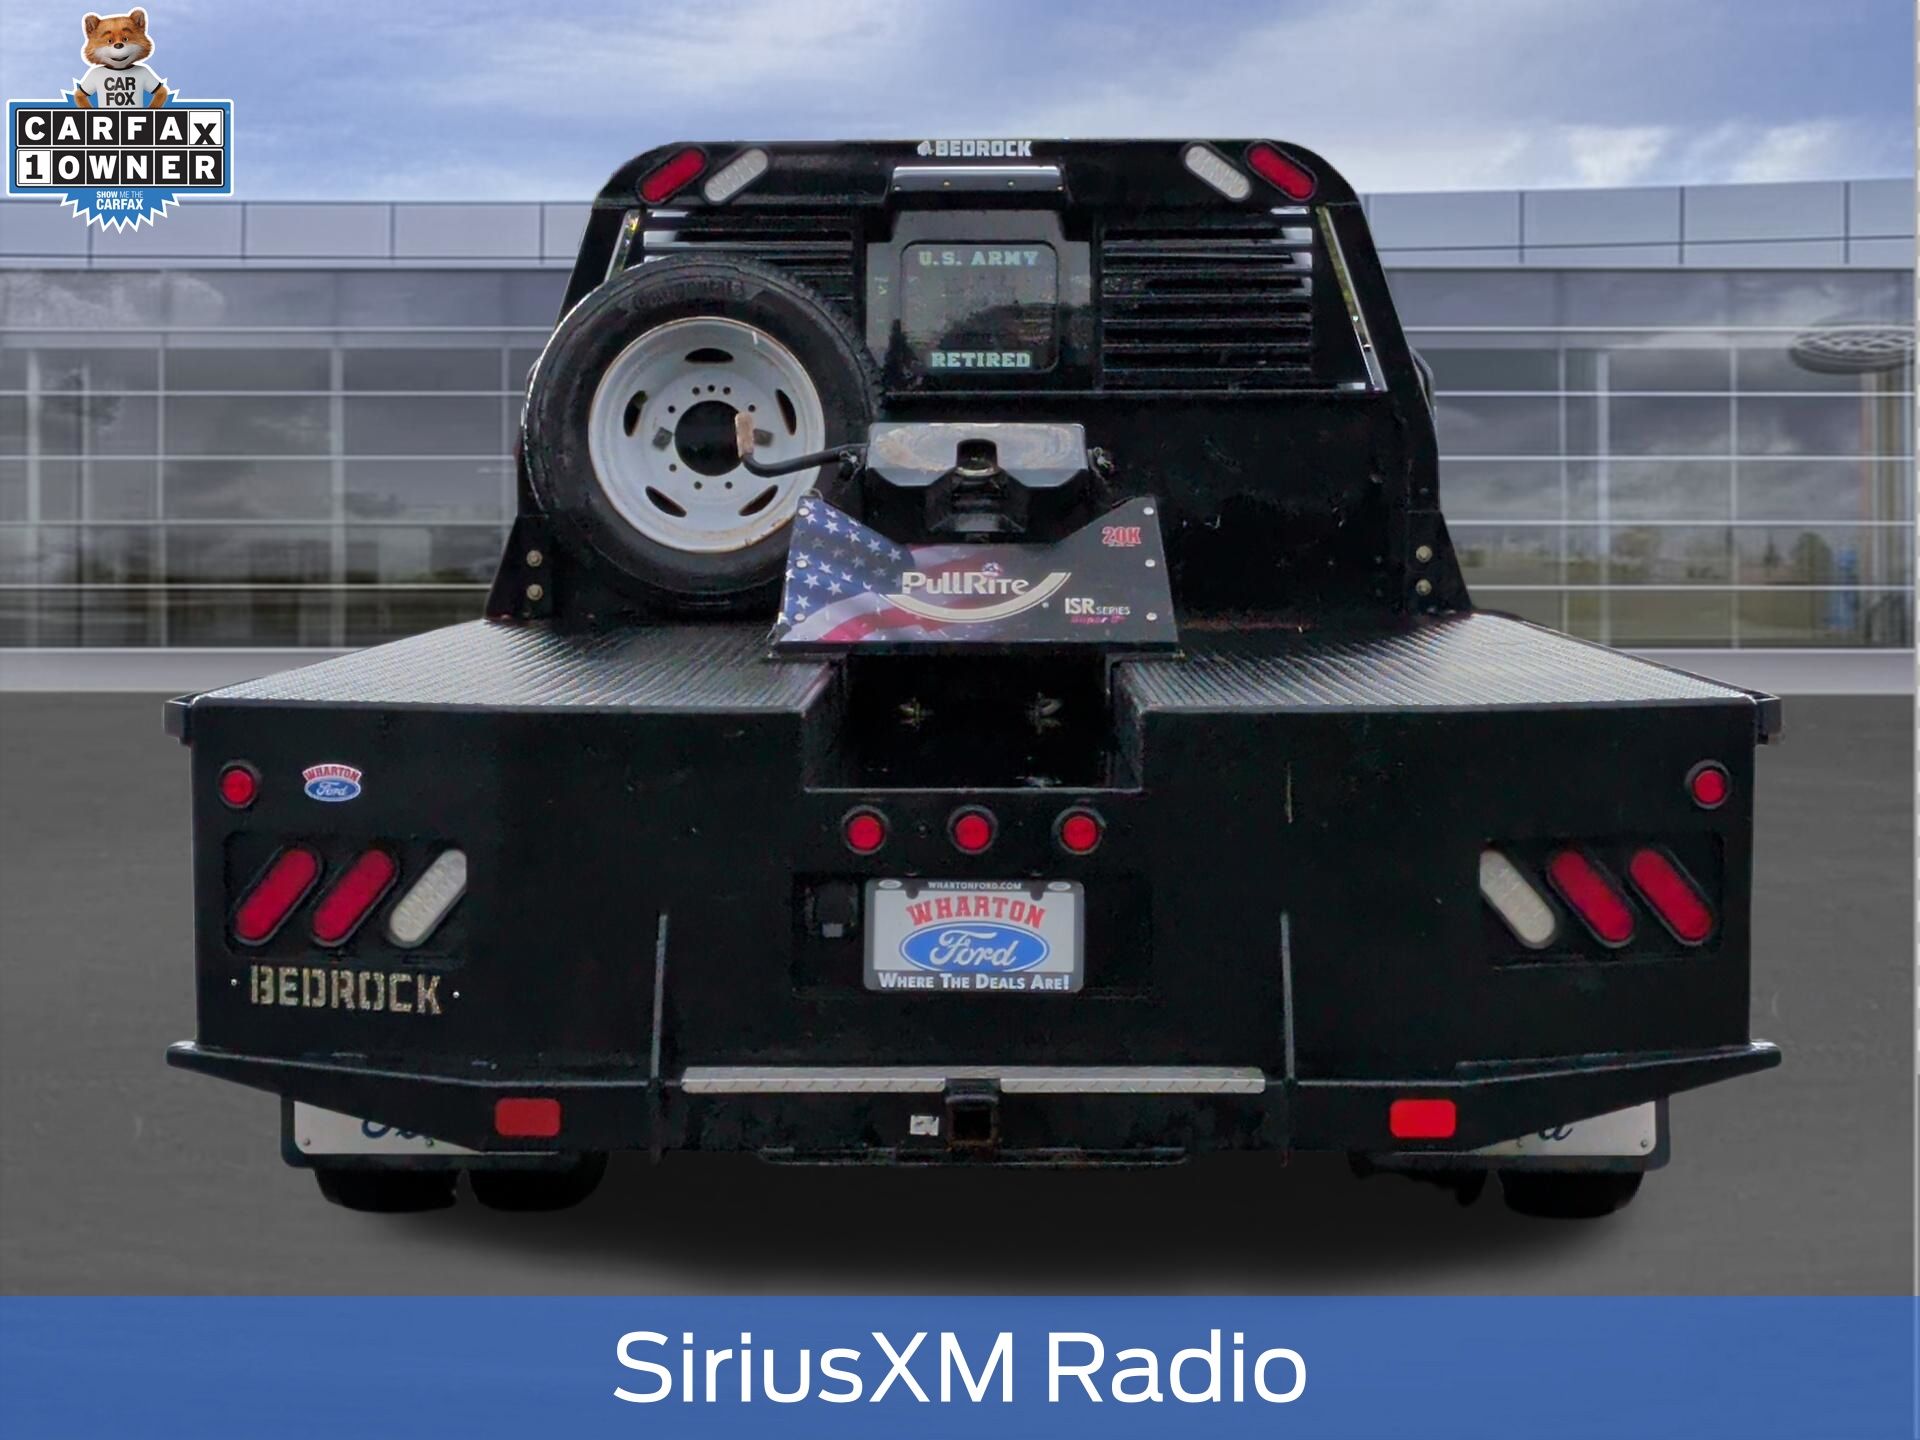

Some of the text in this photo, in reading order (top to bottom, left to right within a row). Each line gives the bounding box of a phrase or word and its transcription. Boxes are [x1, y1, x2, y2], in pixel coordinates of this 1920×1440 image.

[935, 140, 1032, 157] BEDROCK
[919, 251, 1039, 266] U.S. ARMY
[931, 352, 1031, 368] RETIRED
[1102, 526, 1142, 545] 20K
[1064, 597, 1131, 616] ISR SERIES
[304, 766, 360, 781] WHARTON
[316, 782, 348, 796] Ford
[906, 896, 1046, 928] WHARTON
[929, 930, 1018, 966] Ford
[250, 965, 442, 1015] BEDROCK
